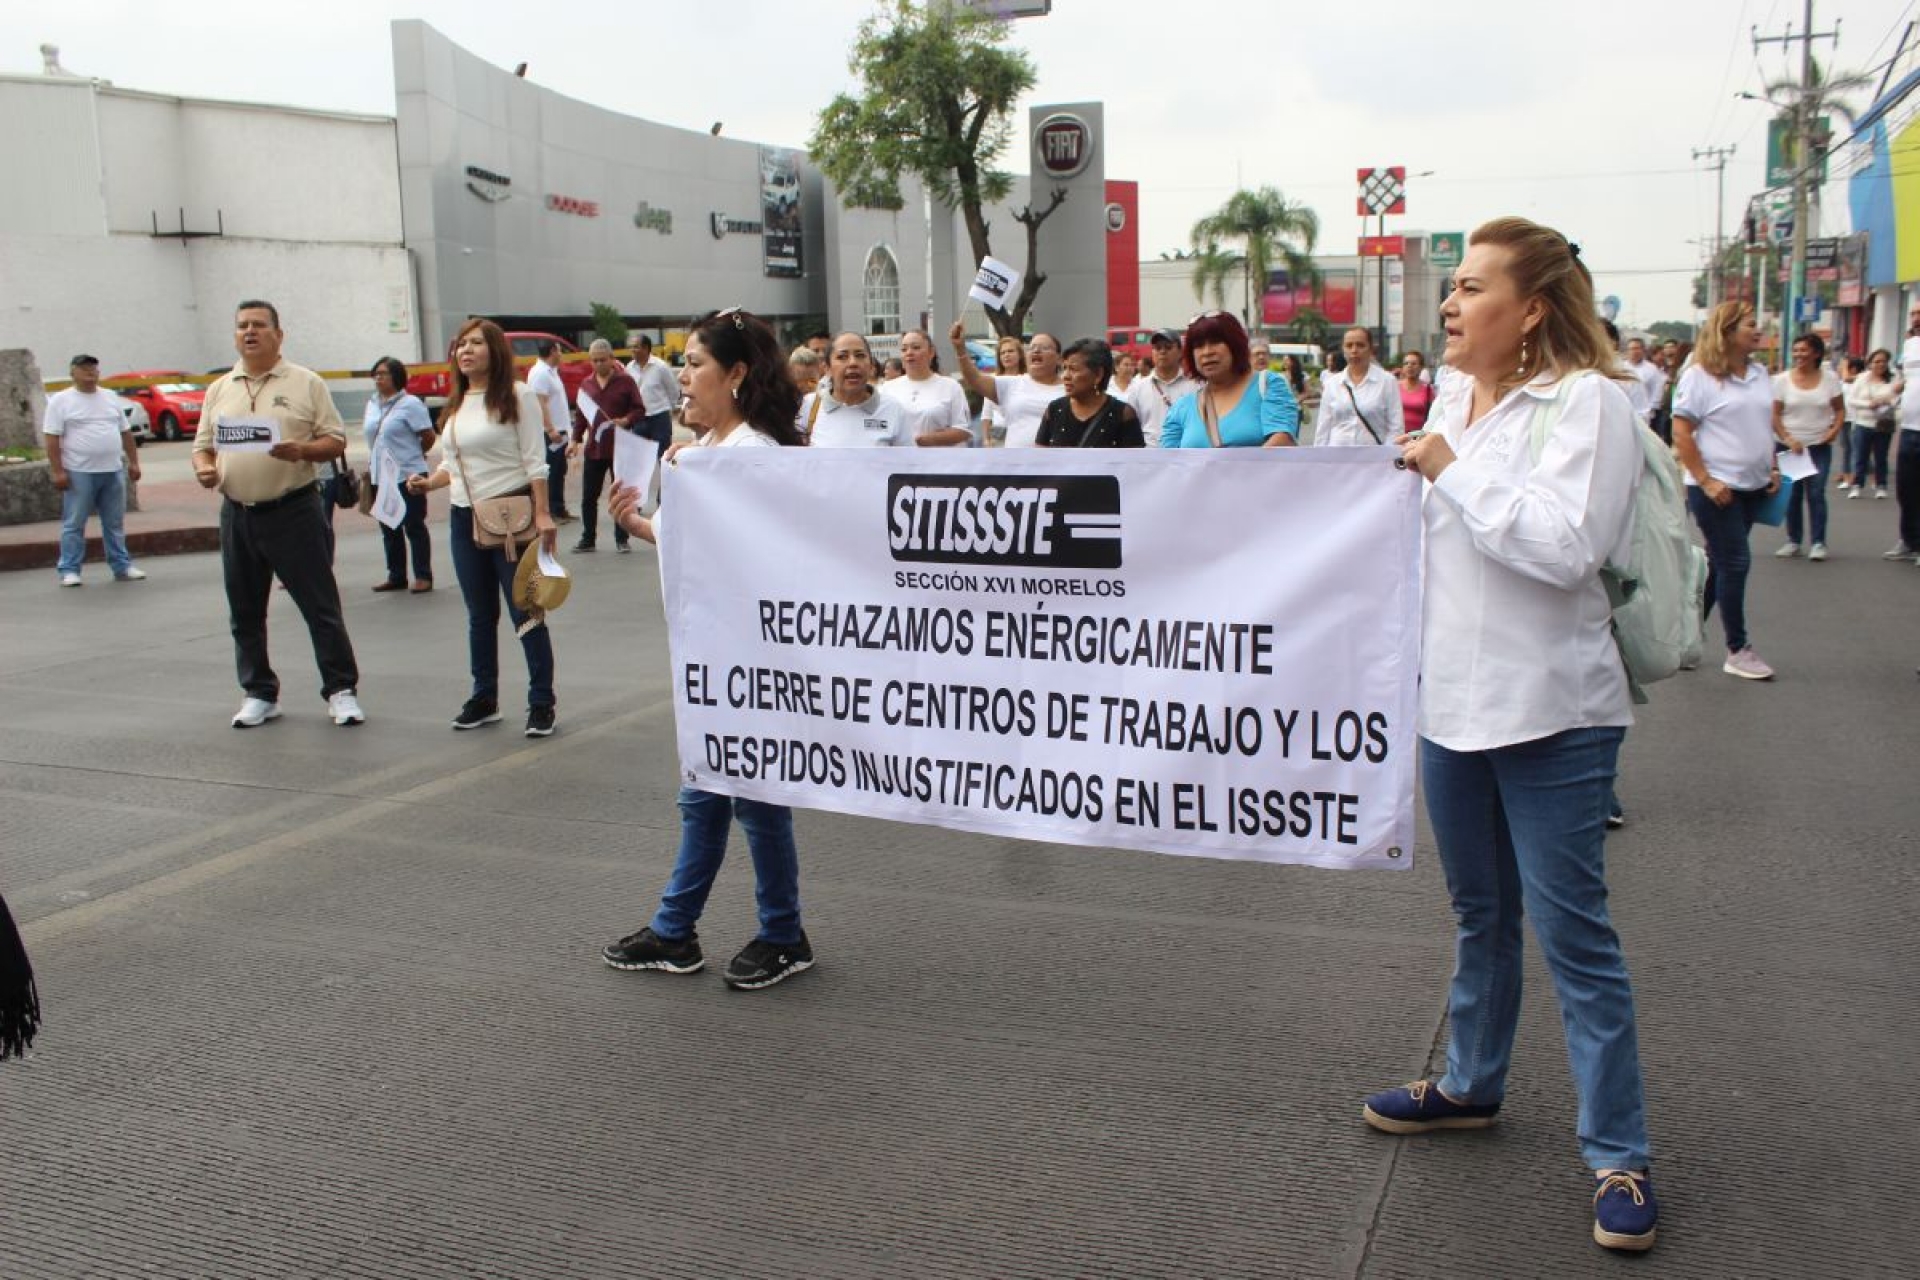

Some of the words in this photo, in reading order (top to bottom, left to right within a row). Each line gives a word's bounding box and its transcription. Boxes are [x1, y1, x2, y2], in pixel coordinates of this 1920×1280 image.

[1045, 130, 1081, 161] FIAT
[890, 485, 1058, 555] SITISSSTE
[895, 570, 978, 593] SECCIÓN
[983, 575, 1016, 595] XVI
[1021, 578, 1126, 598] MORELOS
[759, 599, 974, 656] RECHAZAMOS
[985, 601, 1273, 675] ENÉRGICAMENTE
[685, 663, 718, 707] EL
[727, 665, 825, 718] CIERRE
[831, 676, 873, 724] DE
[882, 679, 1036, 737] CENTROS
[1047, 692, 1090, 742] DE
[1100, 696, 1263, 757] TRABAJO
[1273, 708, 1300, 759] Y
[1311, 710, 1388, 764] LOS
[704, 732, 847, 788] DESPIDOS
[851, 749, 1103, 823] INJUSTIFICADOS
[1114, 778, 1161, 829] EN
[1172, 783, 1218, 833] EL
[1228, 787, 1359, 846] ISSSTE
